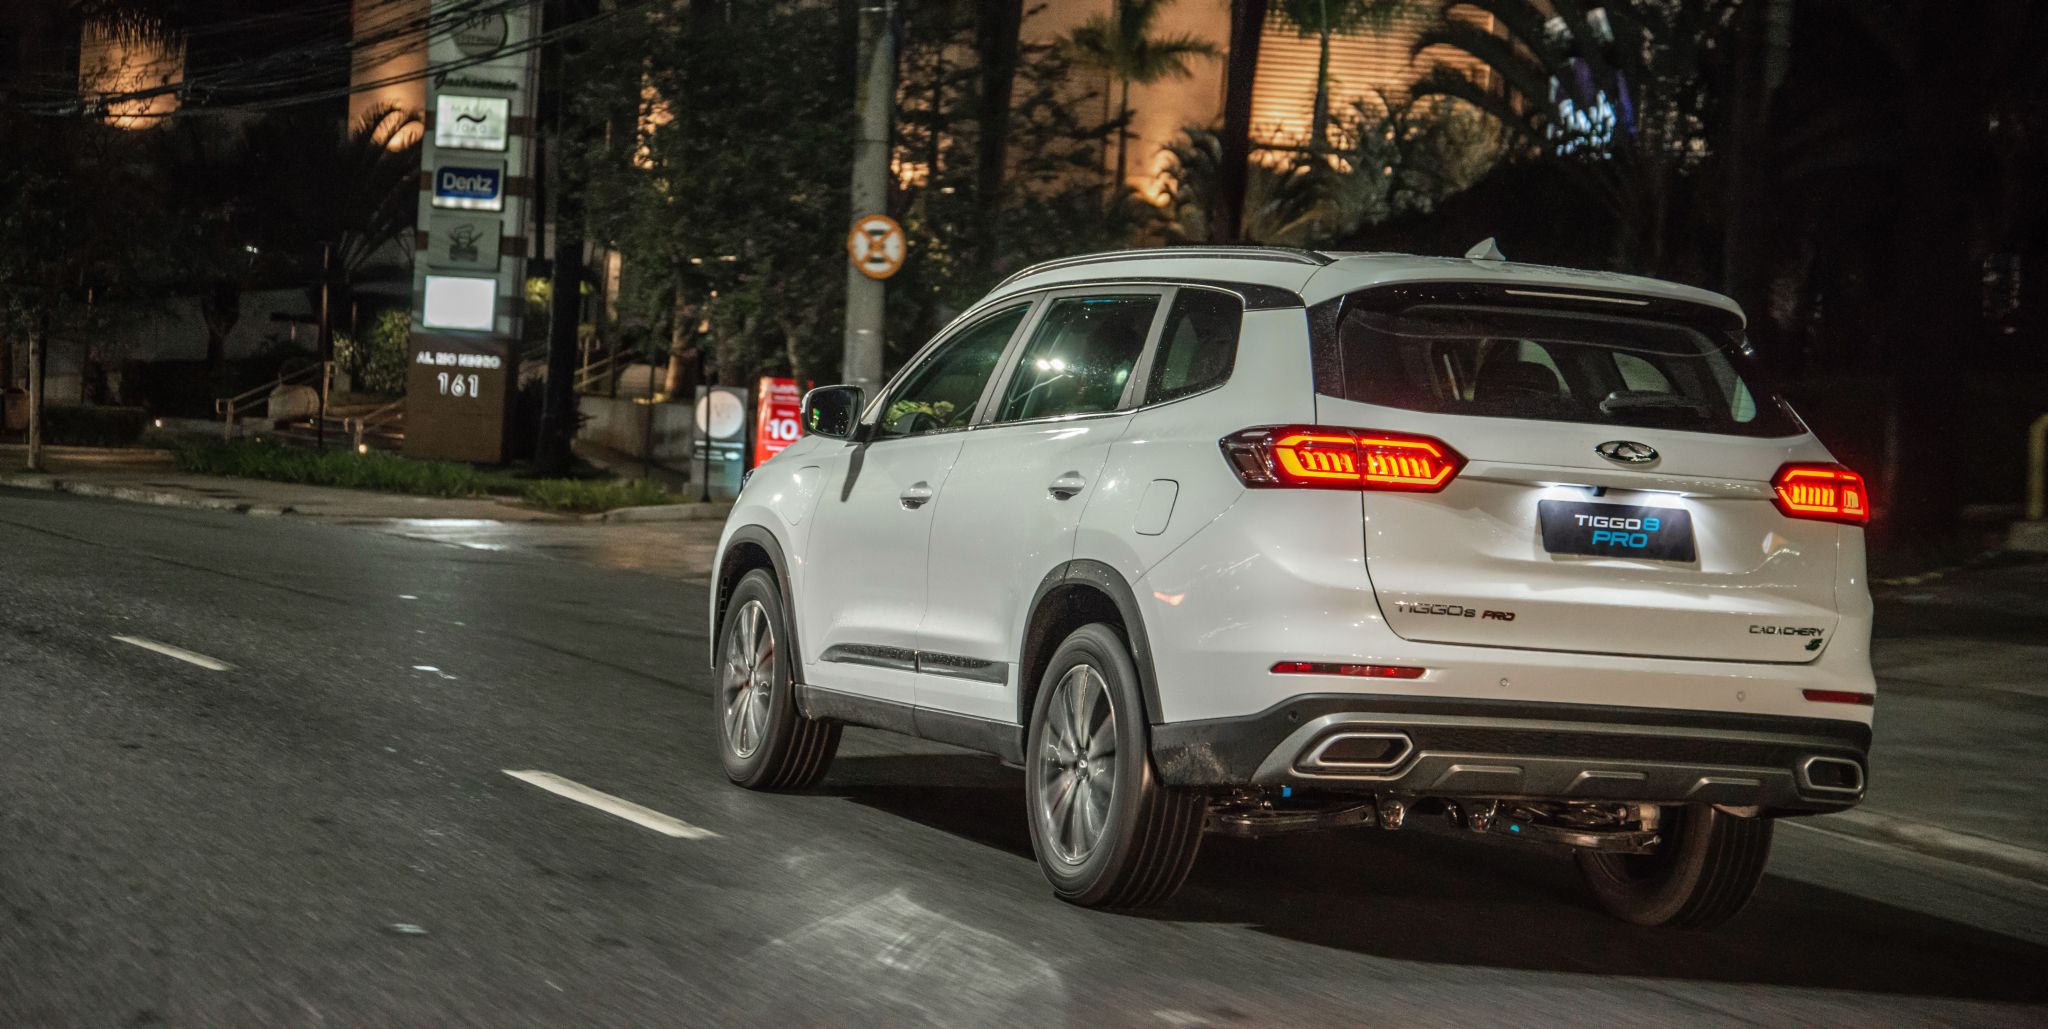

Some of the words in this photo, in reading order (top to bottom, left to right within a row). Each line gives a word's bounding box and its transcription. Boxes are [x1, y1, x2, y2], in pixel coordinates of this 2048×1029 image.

[442, 173, 493, 192] Dentz
[437, 372, 479, 398] 161
[770, 419, 798, 440] 10
[1592, 531, 1648, 548] PRO
[1481, 610, 1515, 621] PRO
